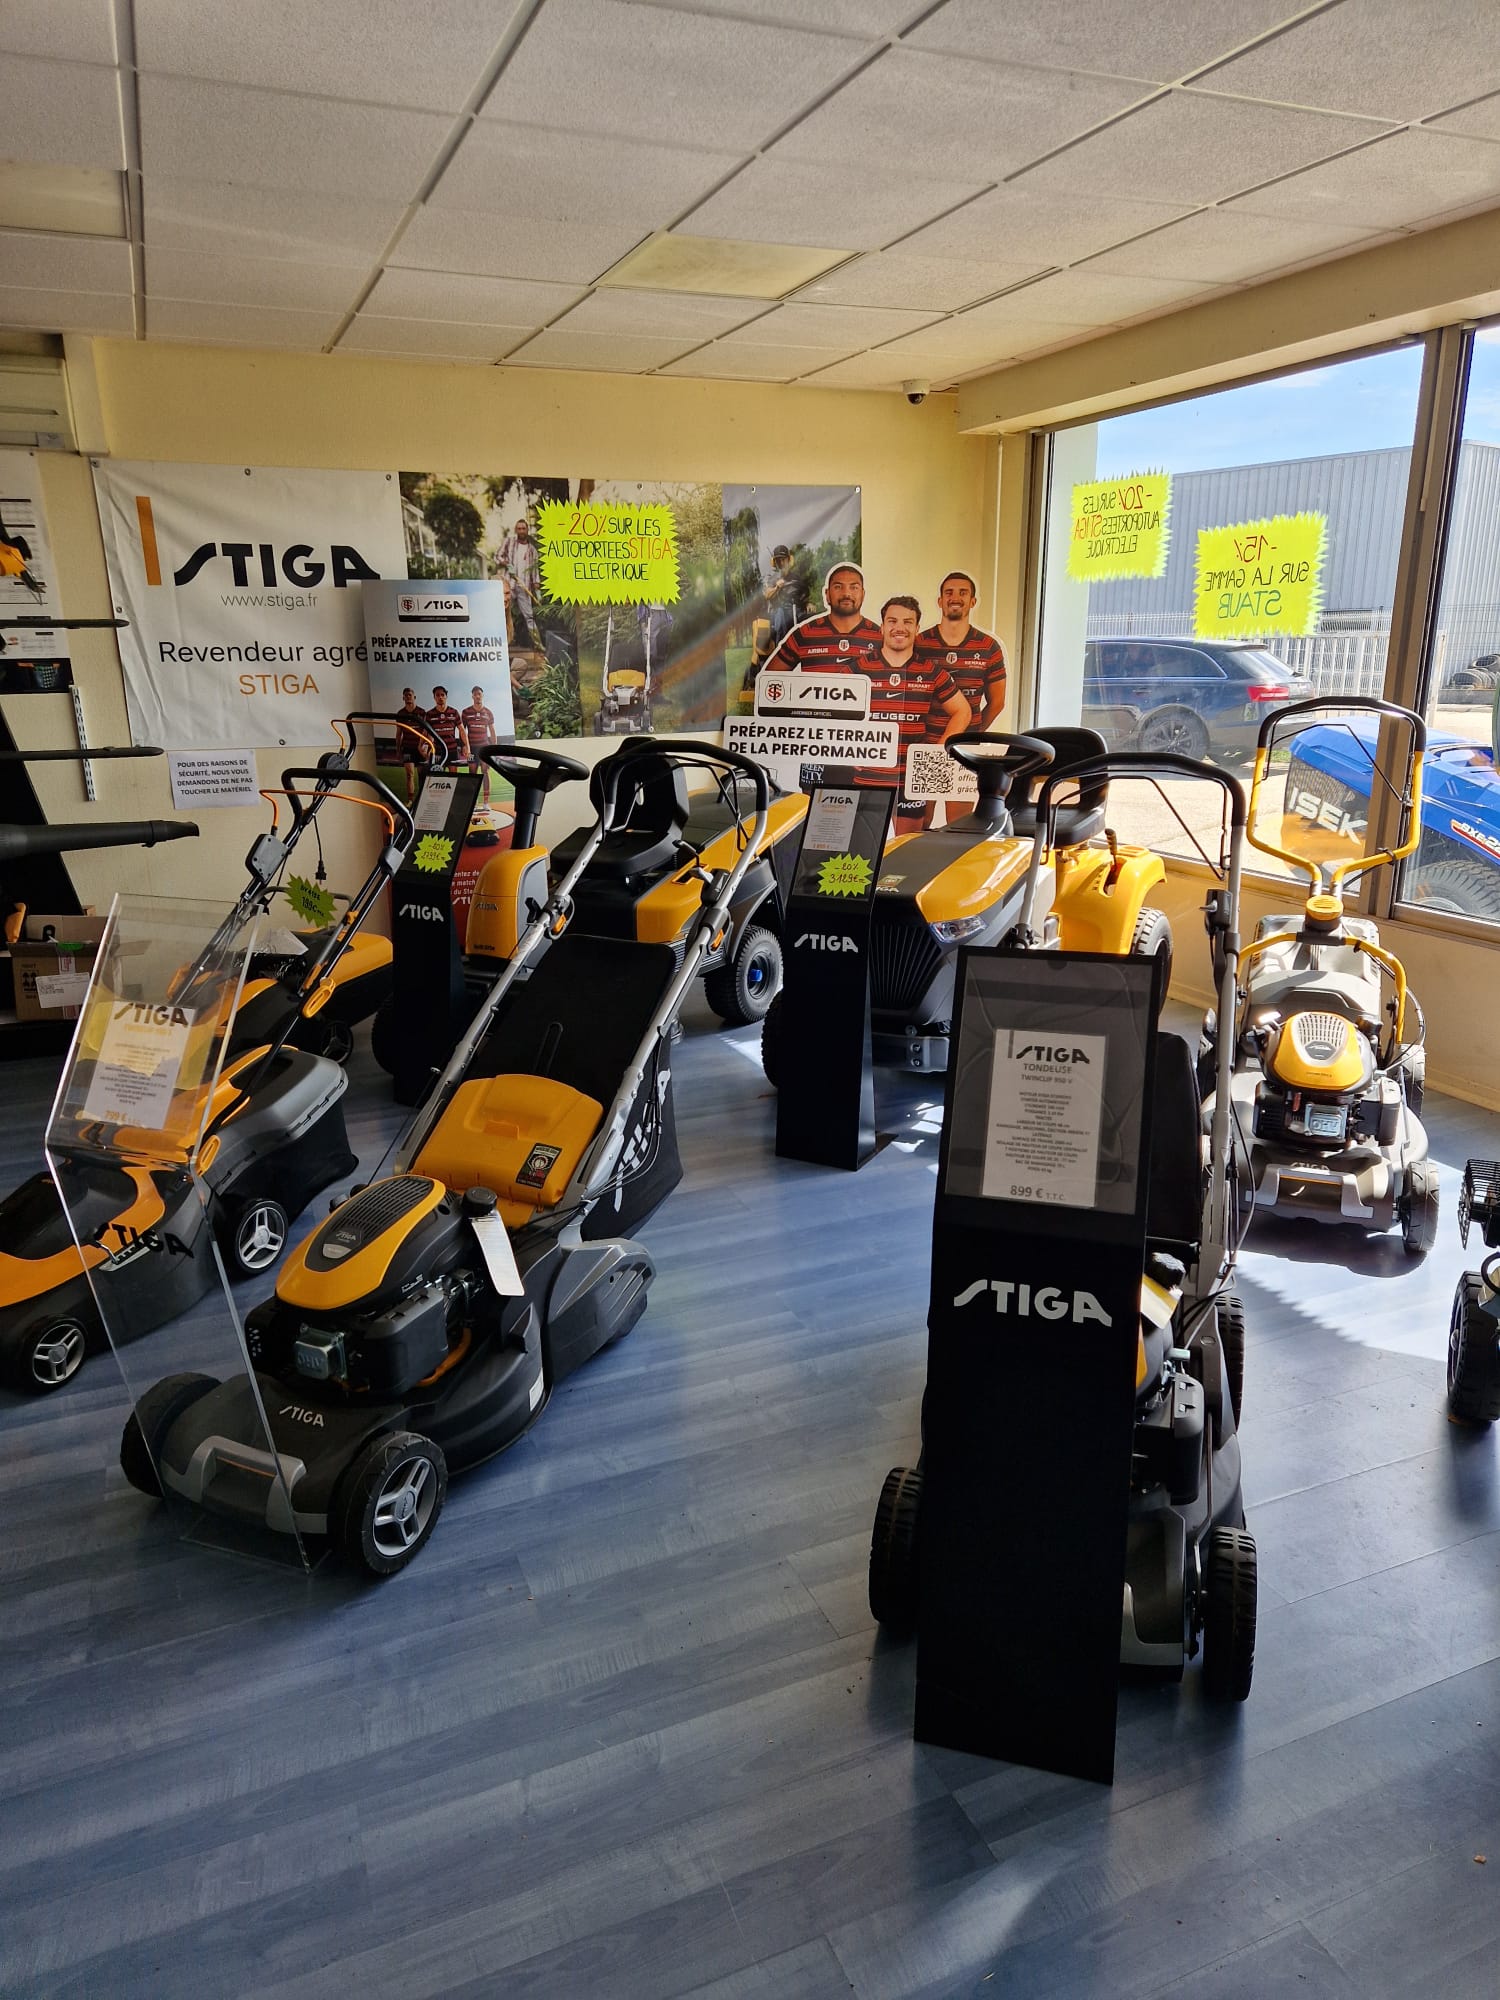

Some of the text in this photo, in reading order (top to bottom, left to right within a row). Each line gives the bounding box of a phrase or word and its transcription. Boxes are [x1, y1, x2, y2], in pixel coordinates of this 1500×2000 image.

[557, 513, 661, 537] -20% SUR LES
[548, 537, 674, 560] AUTOPORTEES STIGA
[174, 542, 382, 588] STIGA
[574, 562, 649, 581] ELECTRIQUE
[220, 593, 319, 610] www.stiga.fr
[424, 600, 464, 610] STIGA
[371, 634, 503, 648] PRÉPAREZ LE TERRAIN
[158, 640, 368, 669] Revendeur agré
[374, 651, 502, 663] DE LA PERFORMANCE
[239, 673, 320, 695] STIGA
[799, 687, 857, 701] STIGA
[729, 722, 892, 744] PRÉPAREZ LE TERRAIN
[729, 742, 887, 760] DE LA PERFORMANCE
[177, 779, 220, 787] DEMANDONS
[428, 781, 452, 790] STIGA
[958, 774, 978, 782] offic
[220, 785, 252, 793] MATÉRIEL
[821, 796, 853, 805] STIGA
[1287, 786, 1369, 846] ISEK
[399, 903, 445, 922] STIGA
[794, 933, 859, 953] STIGA
[114, 1002, 189, 1029] STIGA
[1016, 1045, 1090, 1065] STIGA
[1023, 1063, 1073, 1074] TONDEUSE
[1010, 1184, 1033, 1198] 899
[1035, 1187, 1044, 1199] €
[954, 1279, 1112, 1328] STIGA
[279, 1405, 324, 1427] STIGA
